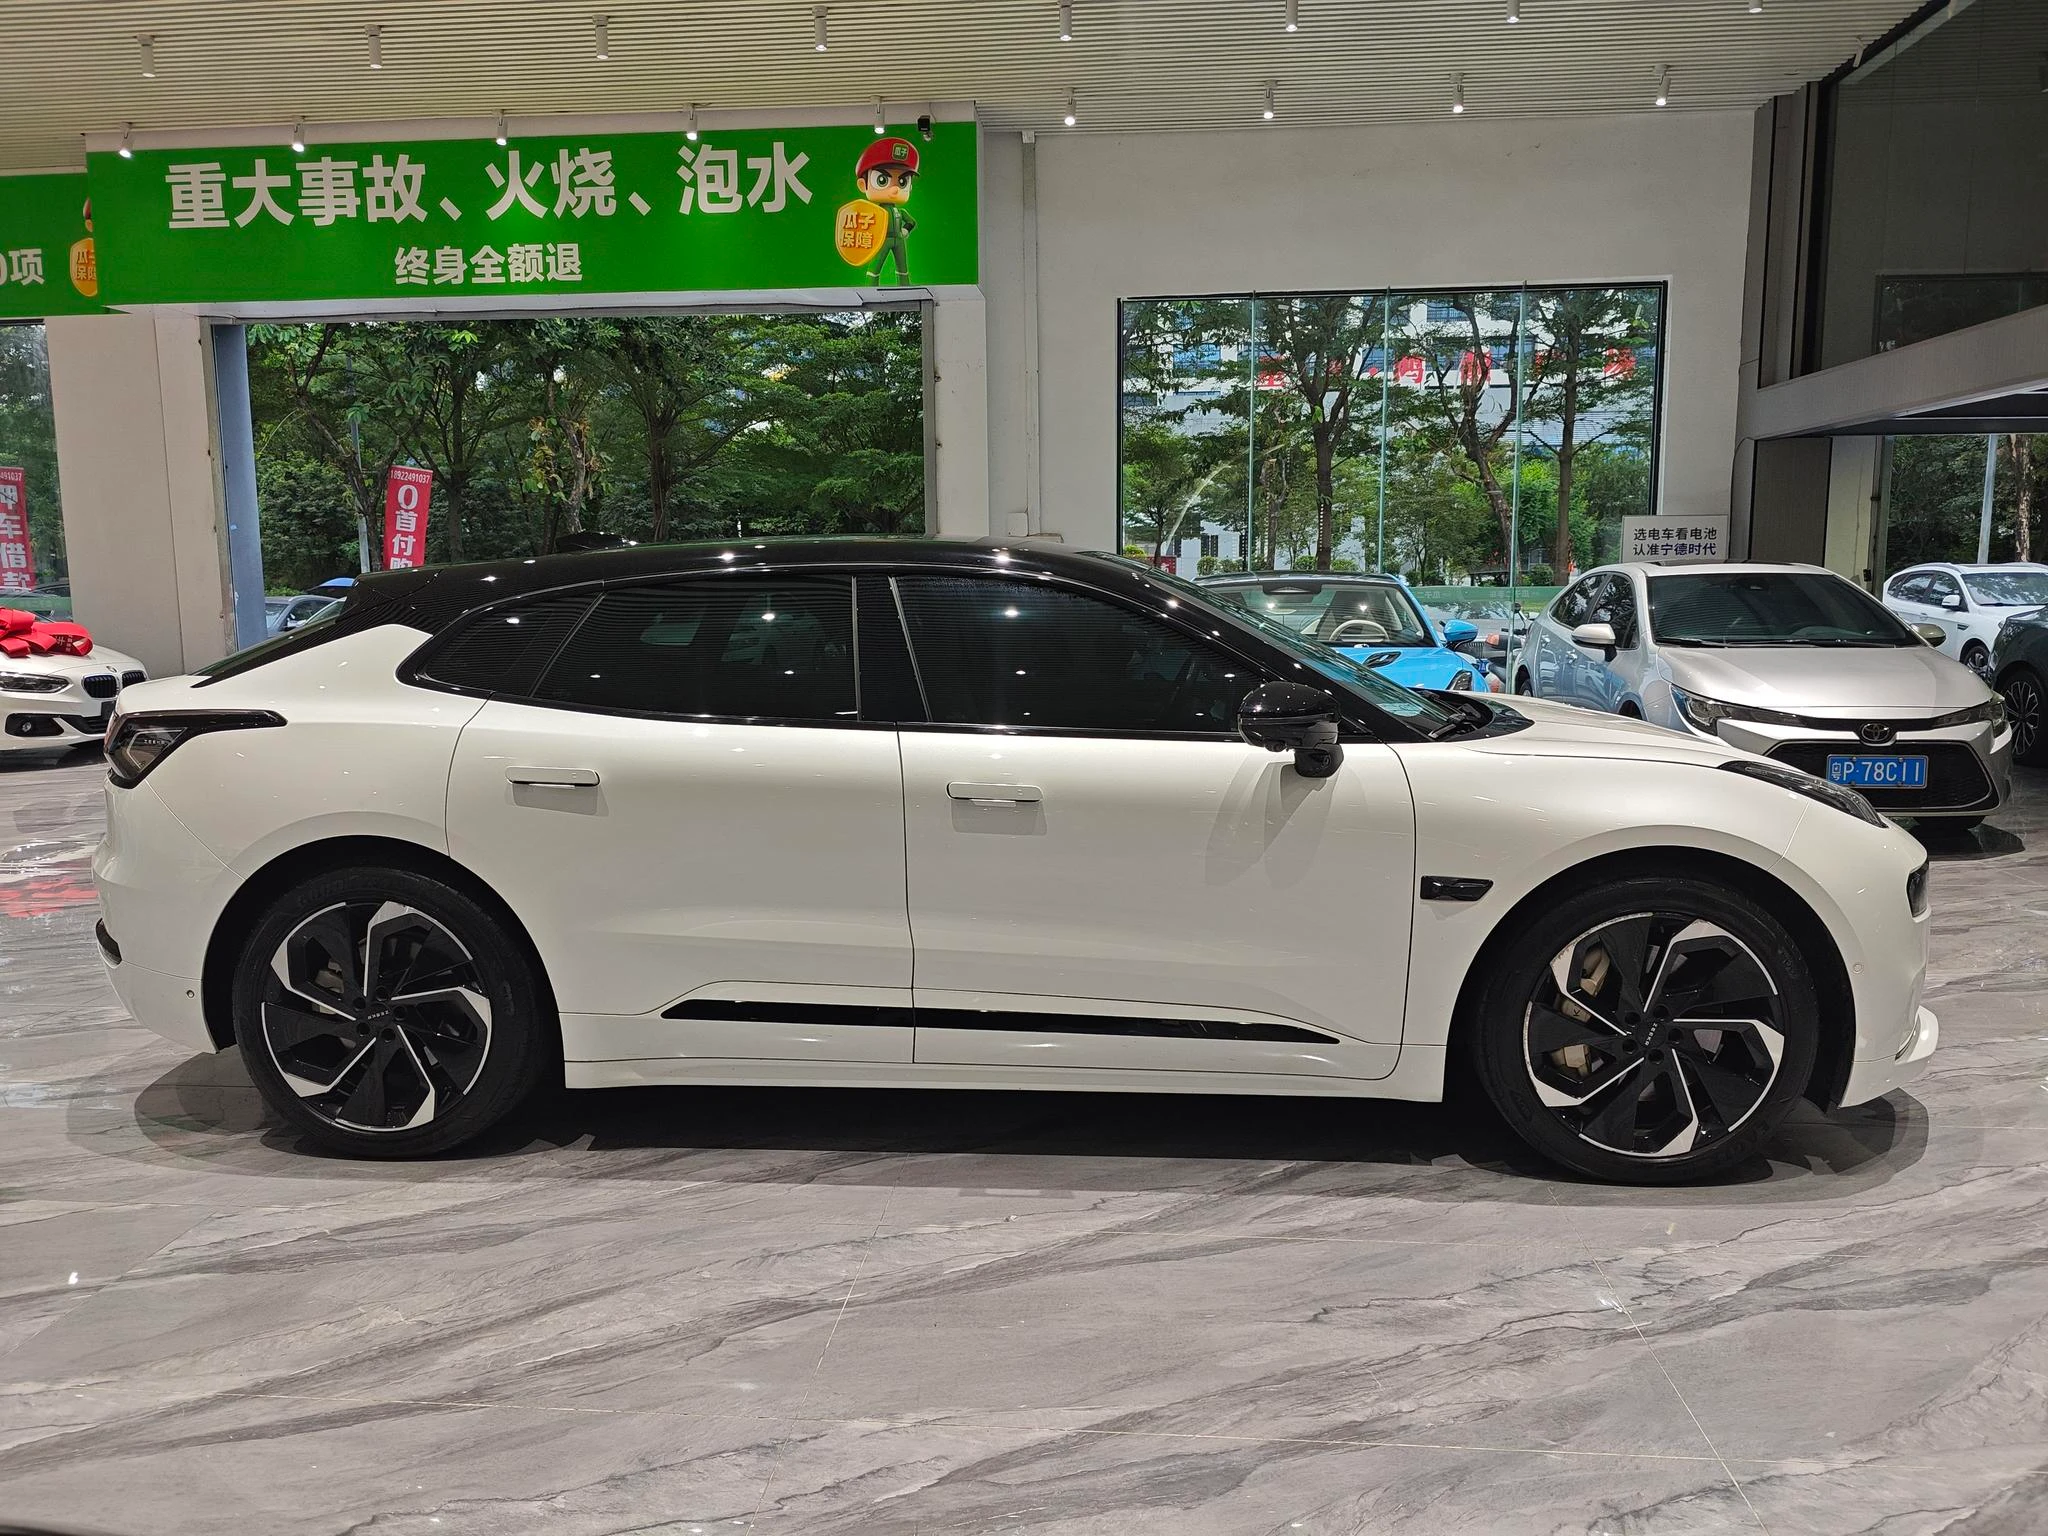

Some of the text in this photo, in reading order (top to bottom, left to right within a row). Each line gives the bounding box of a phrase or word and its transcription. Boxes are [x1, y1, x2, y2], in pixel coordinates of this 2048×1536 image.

[165, 141, 813, 229] 重大事故、火烧、泡水
[844, 211, 875, 230] 瓜子
[840, 231, 873, 249] 保障
[394, 243, 583, 286] 终身全额退
[390, 469, 430, 484] 18922491037
[1633, 527, 1717, 541] 选电车看电池
[1633, 543, 1717, 556] 认准宁德时代
